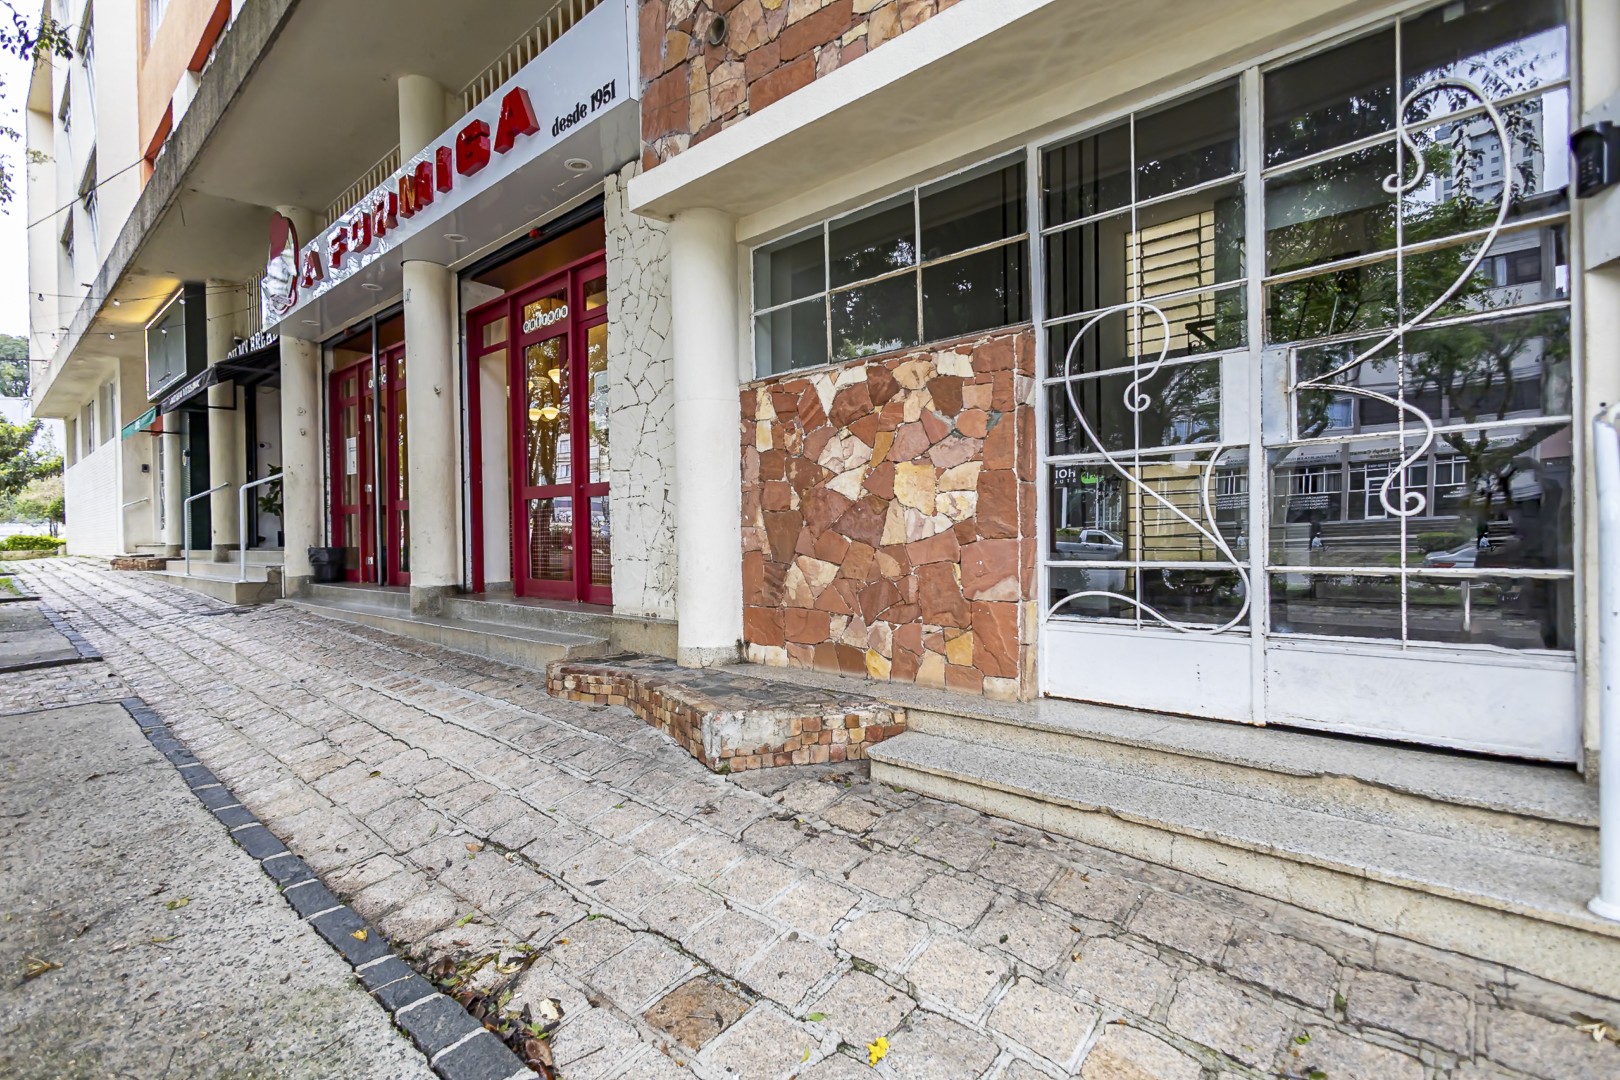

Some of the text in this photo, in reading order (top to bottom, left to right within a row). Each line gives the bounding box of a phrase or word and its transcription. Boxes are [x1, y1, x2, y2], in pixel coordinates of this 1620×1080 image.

[551, 78, 617, 138] desde 1951
[301, 86, 540, 288] A FORMIGA
[523, 304, 568, 333] entrada
